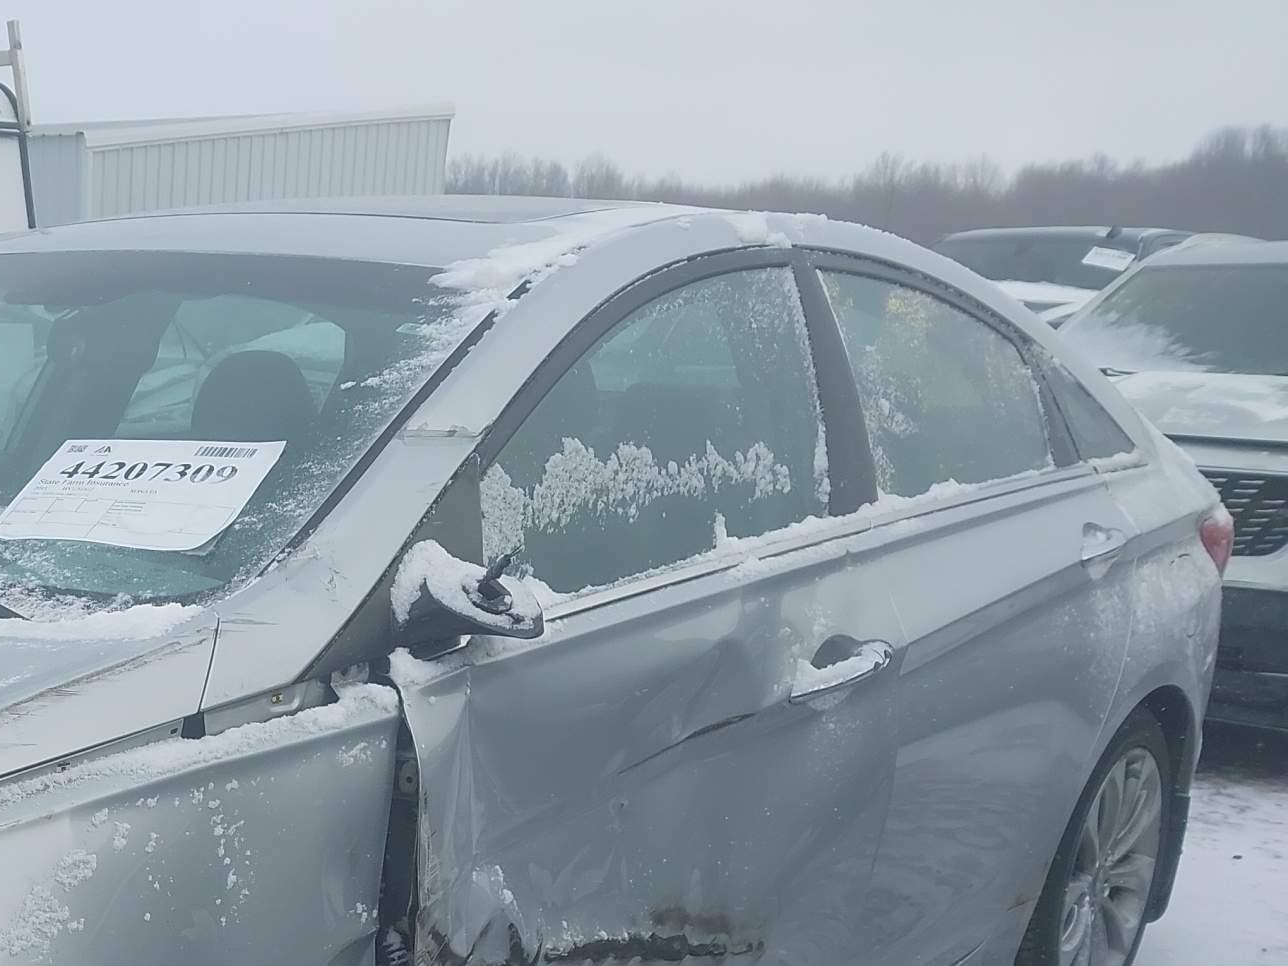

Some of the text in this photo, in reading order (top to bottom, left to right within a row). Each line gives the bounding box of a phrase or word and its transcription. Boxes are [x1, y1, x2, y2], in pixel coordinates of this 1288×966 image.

[59, 460, 239, 484] 44207309
[38, 478, 61, 486] State
[86, 479, 130, 488] Insurance
